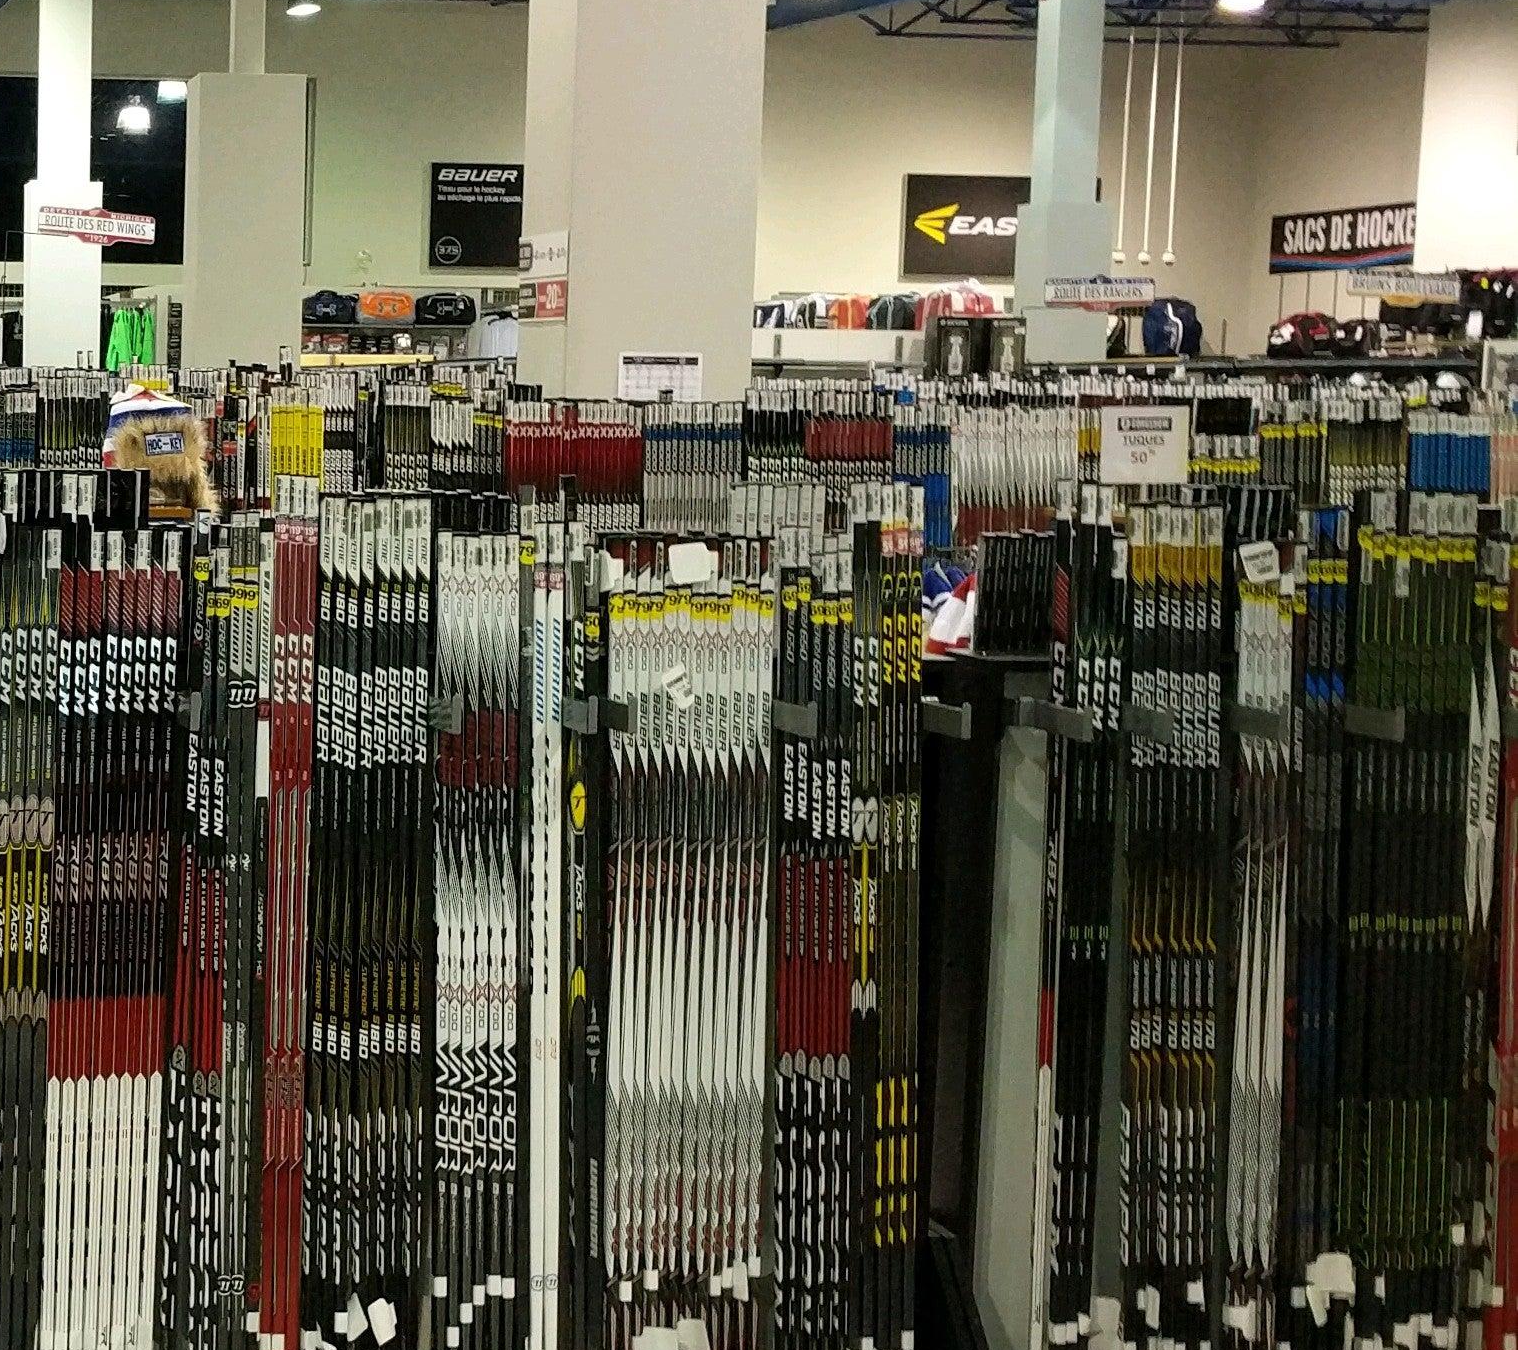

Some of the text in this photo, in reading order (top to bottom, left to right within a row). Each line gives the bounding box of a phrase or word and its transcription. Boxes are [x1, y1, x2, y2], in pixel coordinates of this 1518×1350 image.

[45, 215, 146, 236] ROUTE DES RED WINGS
[482, 186, 505, 195] hockey
[1282, 216, 1326, 255] SACS
[1330, 213, 1353, 250] DE
[0, 631, 12, 705] CCM
[16, 628, 28, 701] CCM
[30, 628, 42, 701] CCM
[46, 627, 58, 702] CCM
[58, 639, 72, 716] CCM
[74, 639, 87, 717] CCM
[88, 637, 100, 715] CCM
[105, 633, 118, 713] CCM
[120, 637, 132, 715] CCM
[134, 636, 146, 713] CCM
[148, 637, 162, 713] CCM
[164, 636, 177, 713] CCM
[274, 633, 284, 705] CCM
[288, 633, 298, 704] CCM
[302, 633, 312, 705] CCM
[574, 620, 584, 691] CCM
[854, 636, 864, 707] CCM
[868, 635, 878, 707] CCM
[883, 615, 892, 685] CCM
[897, 613, 906, 683] CCM
[912, 613, 921, 683] CCM
[1092, 655, 1106, 731] CCM
[1108, 657, 1122, 731] CCM
[187, 732, 198, 812] EASTON
[200, 757, 210, 837] EASTON
[214, 757, 224, 837] EASTON
[784, 743, 794, 822] EASTON
[798, 741, 808, 820] EASTON
[812, 761, 822, 840] EASTON
[826, 759, 836, 838] EASTON
[840, 759, 850, 838] EASTON
